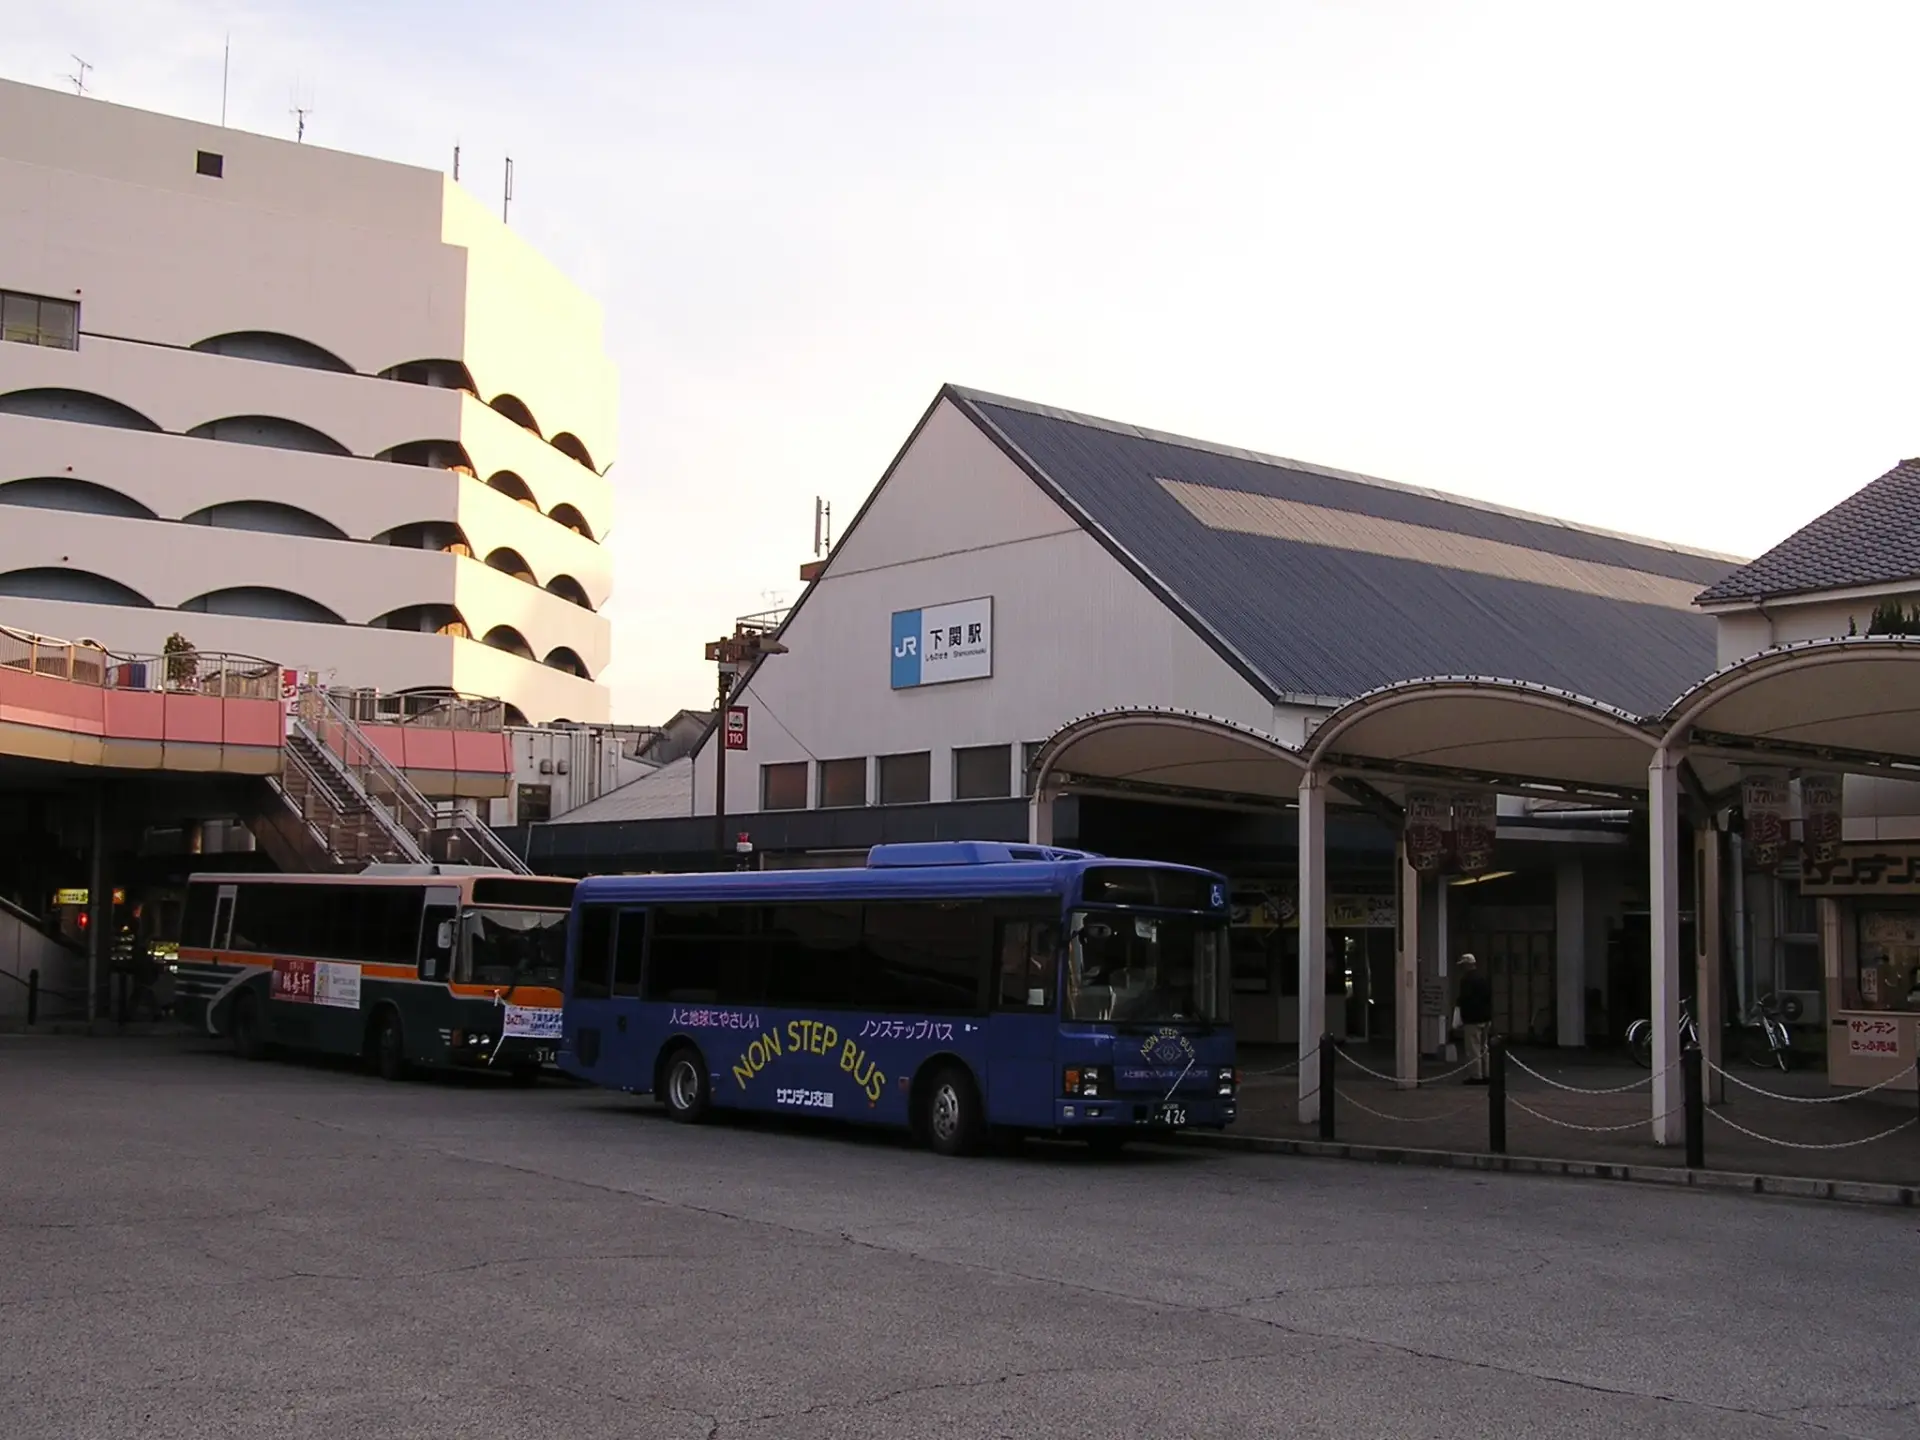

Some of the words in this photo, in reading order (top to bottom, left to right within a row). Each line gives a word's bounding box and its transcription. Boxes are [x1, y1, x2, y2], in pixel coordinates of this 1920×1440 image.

[930, 622, 982, 650] 下関駅
[895, 636, 917, 658] JR
[728, 732, 744, 744] 110
[669, 1008, 760, 1029] 人と地球にやさしい
[1851, 1020, 1897, 1034] サンデン
[860, 1020, 953, 1041] ノンステップバス
[1141, 1034, 1159, 1053] NON
[1159, 1028, 1178, 1039] STEP
[732, 1027, 782, 1090] NON
[787, 1020, 838, 1056] STEP
[840, 1038, 887, 1101] BUS
